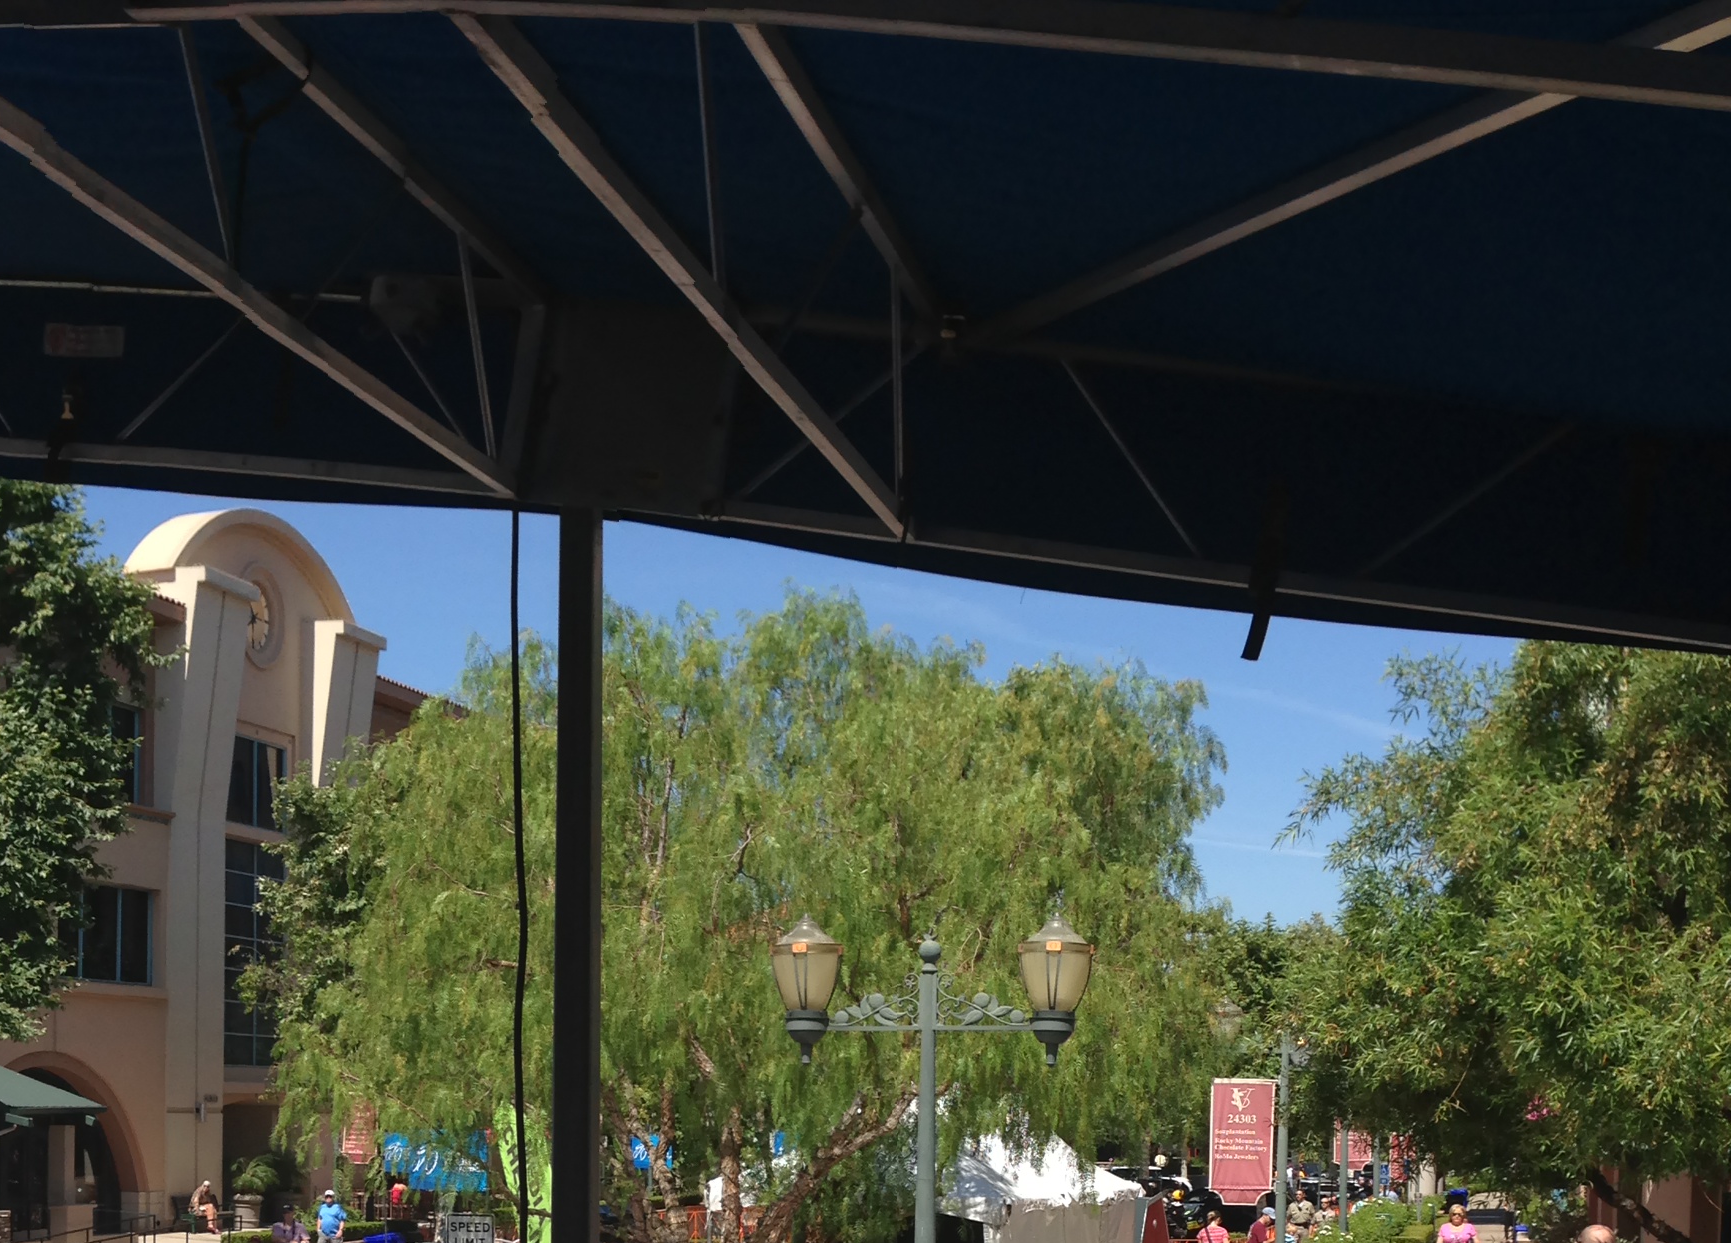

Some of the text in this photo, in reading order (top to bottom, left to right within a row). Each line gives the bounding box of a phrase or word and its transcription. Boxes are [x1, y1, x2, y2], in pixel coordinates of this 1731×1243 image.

[1227, 1114, 1257, 1124] 24303
[1235, 1138, 1263, 1146] Mountain
[1215, 1144, 1267, 1152] Chocolate Factory
[450, 1222, 490, 1233] SPEED
